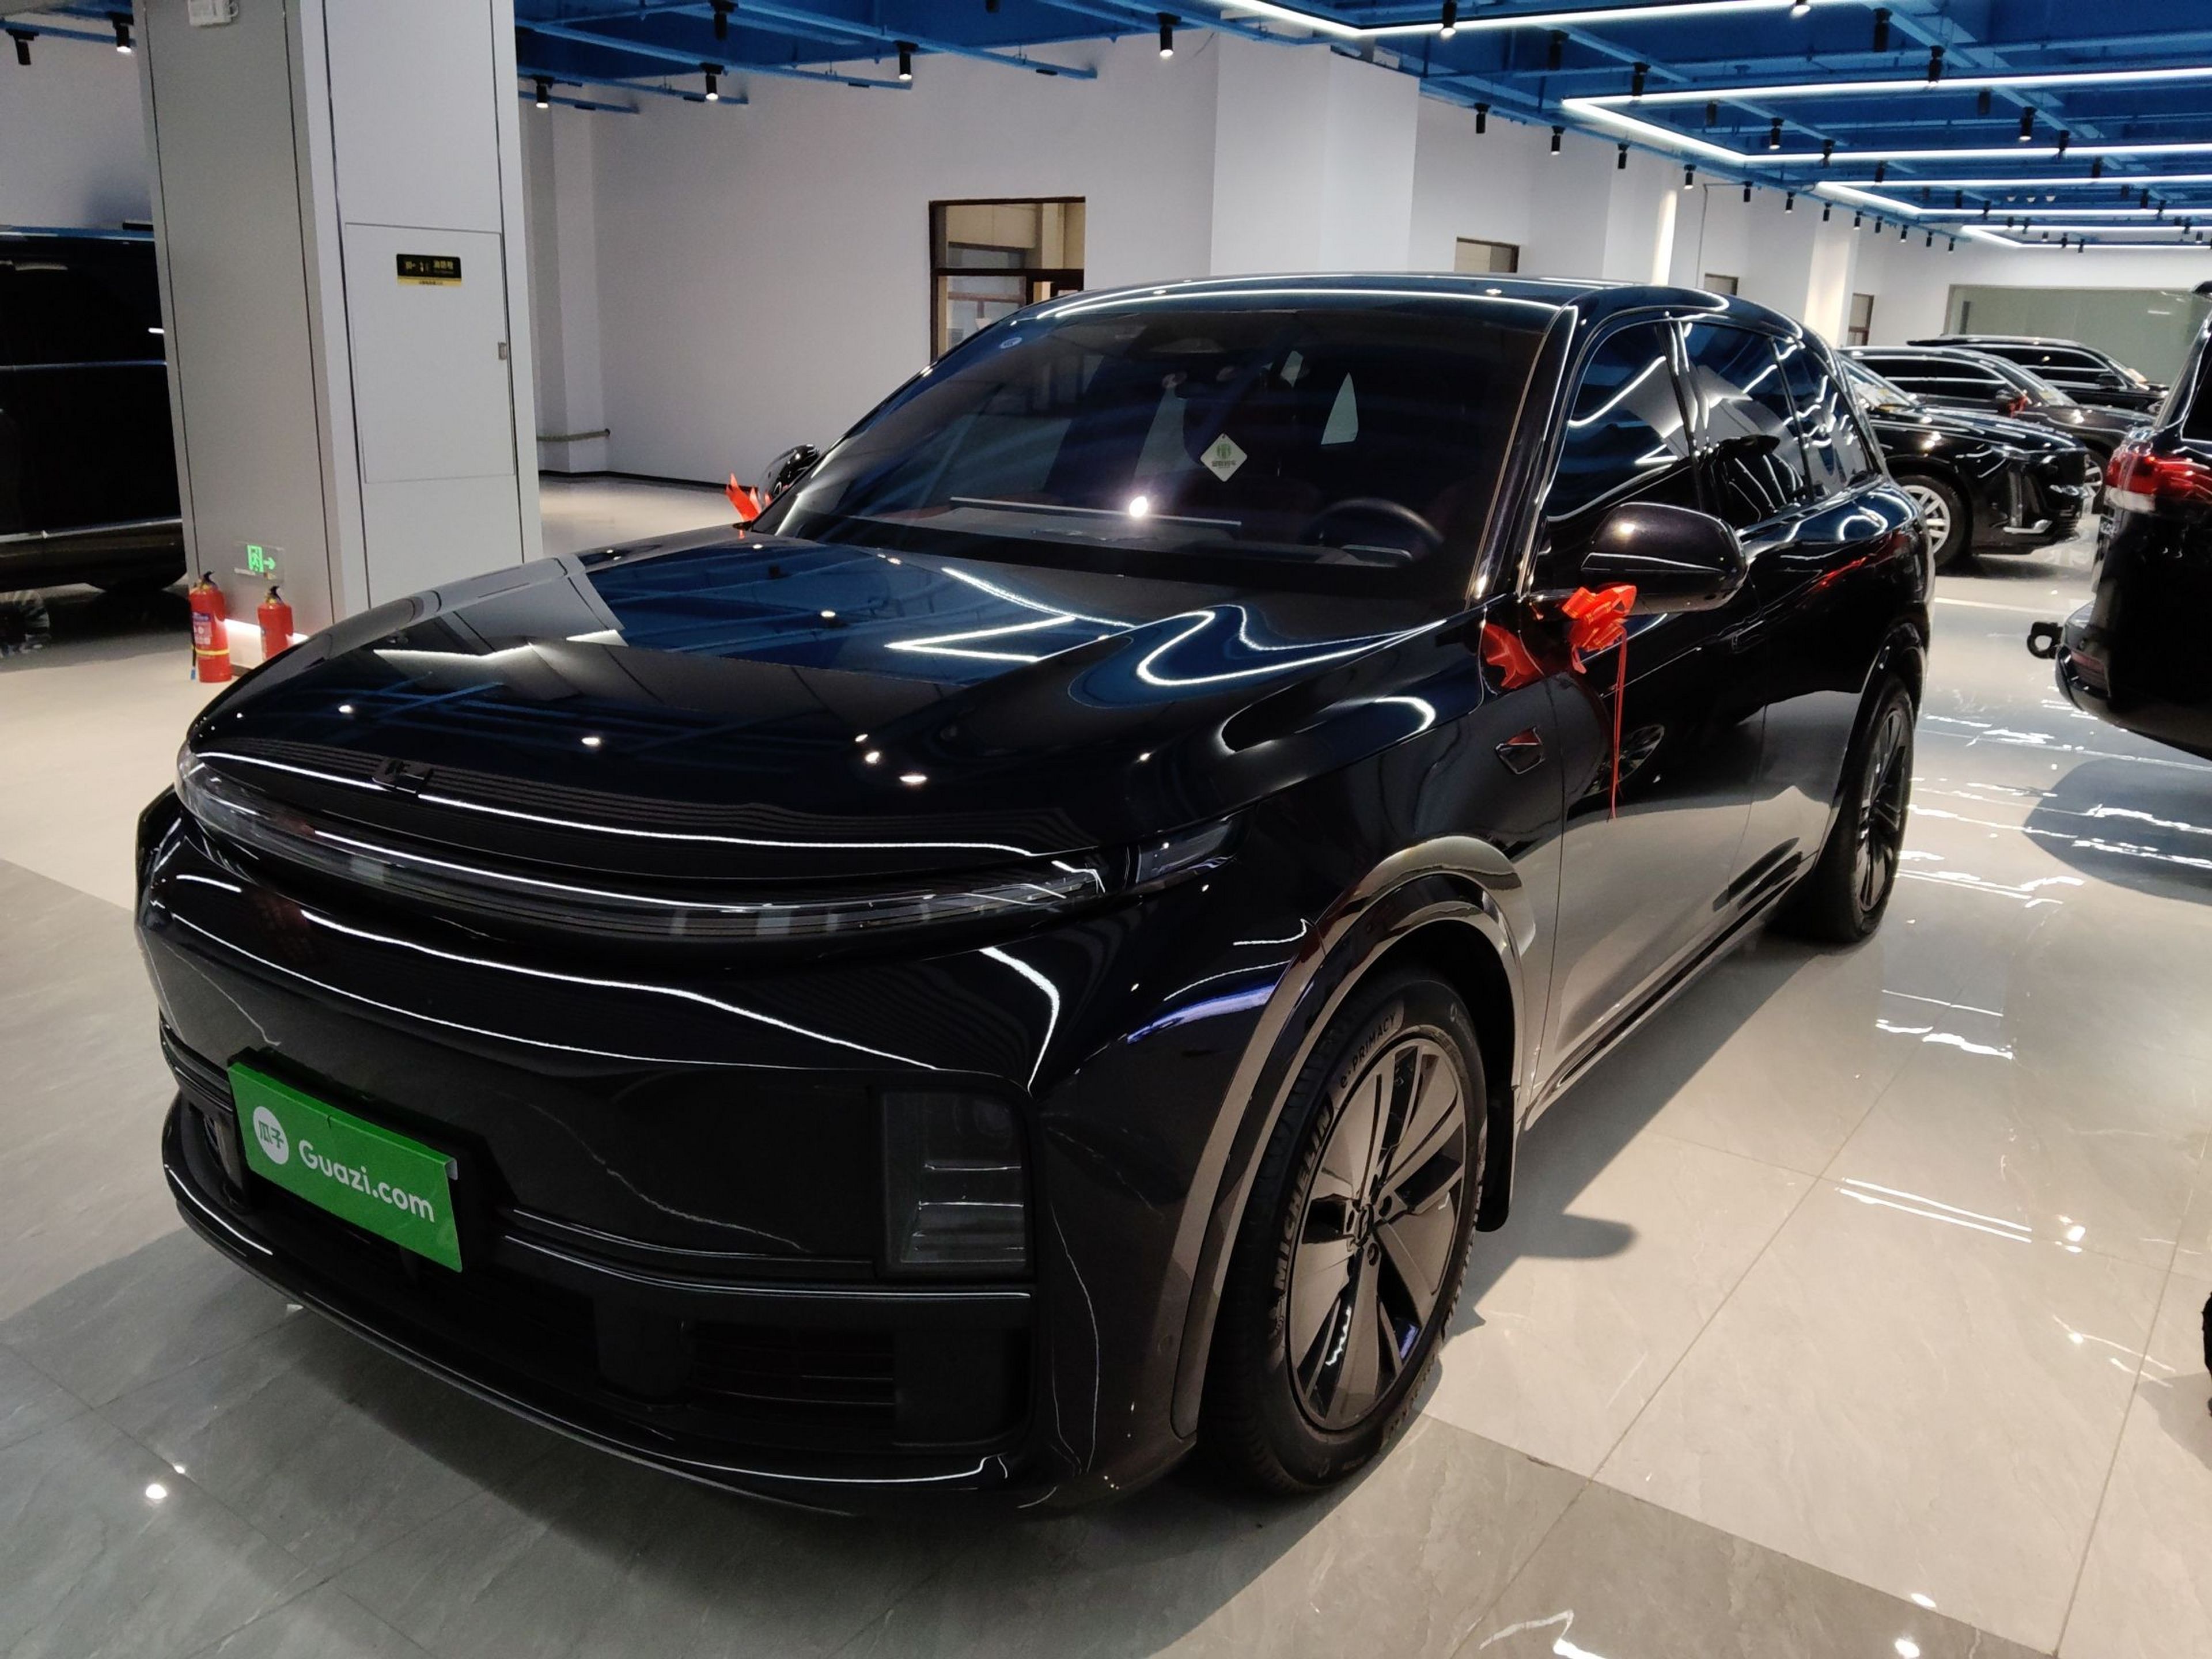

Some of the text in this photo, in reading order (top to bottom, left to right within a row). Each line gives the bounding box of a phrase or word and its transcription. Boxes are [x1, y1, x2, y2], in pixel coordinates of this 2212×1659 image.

[258, 1120, 285, 1149] 瓜子
[298, 1139, 435, 1222] Guazi.com
[1273, 1104, 1331, 1291] MICHELIN
